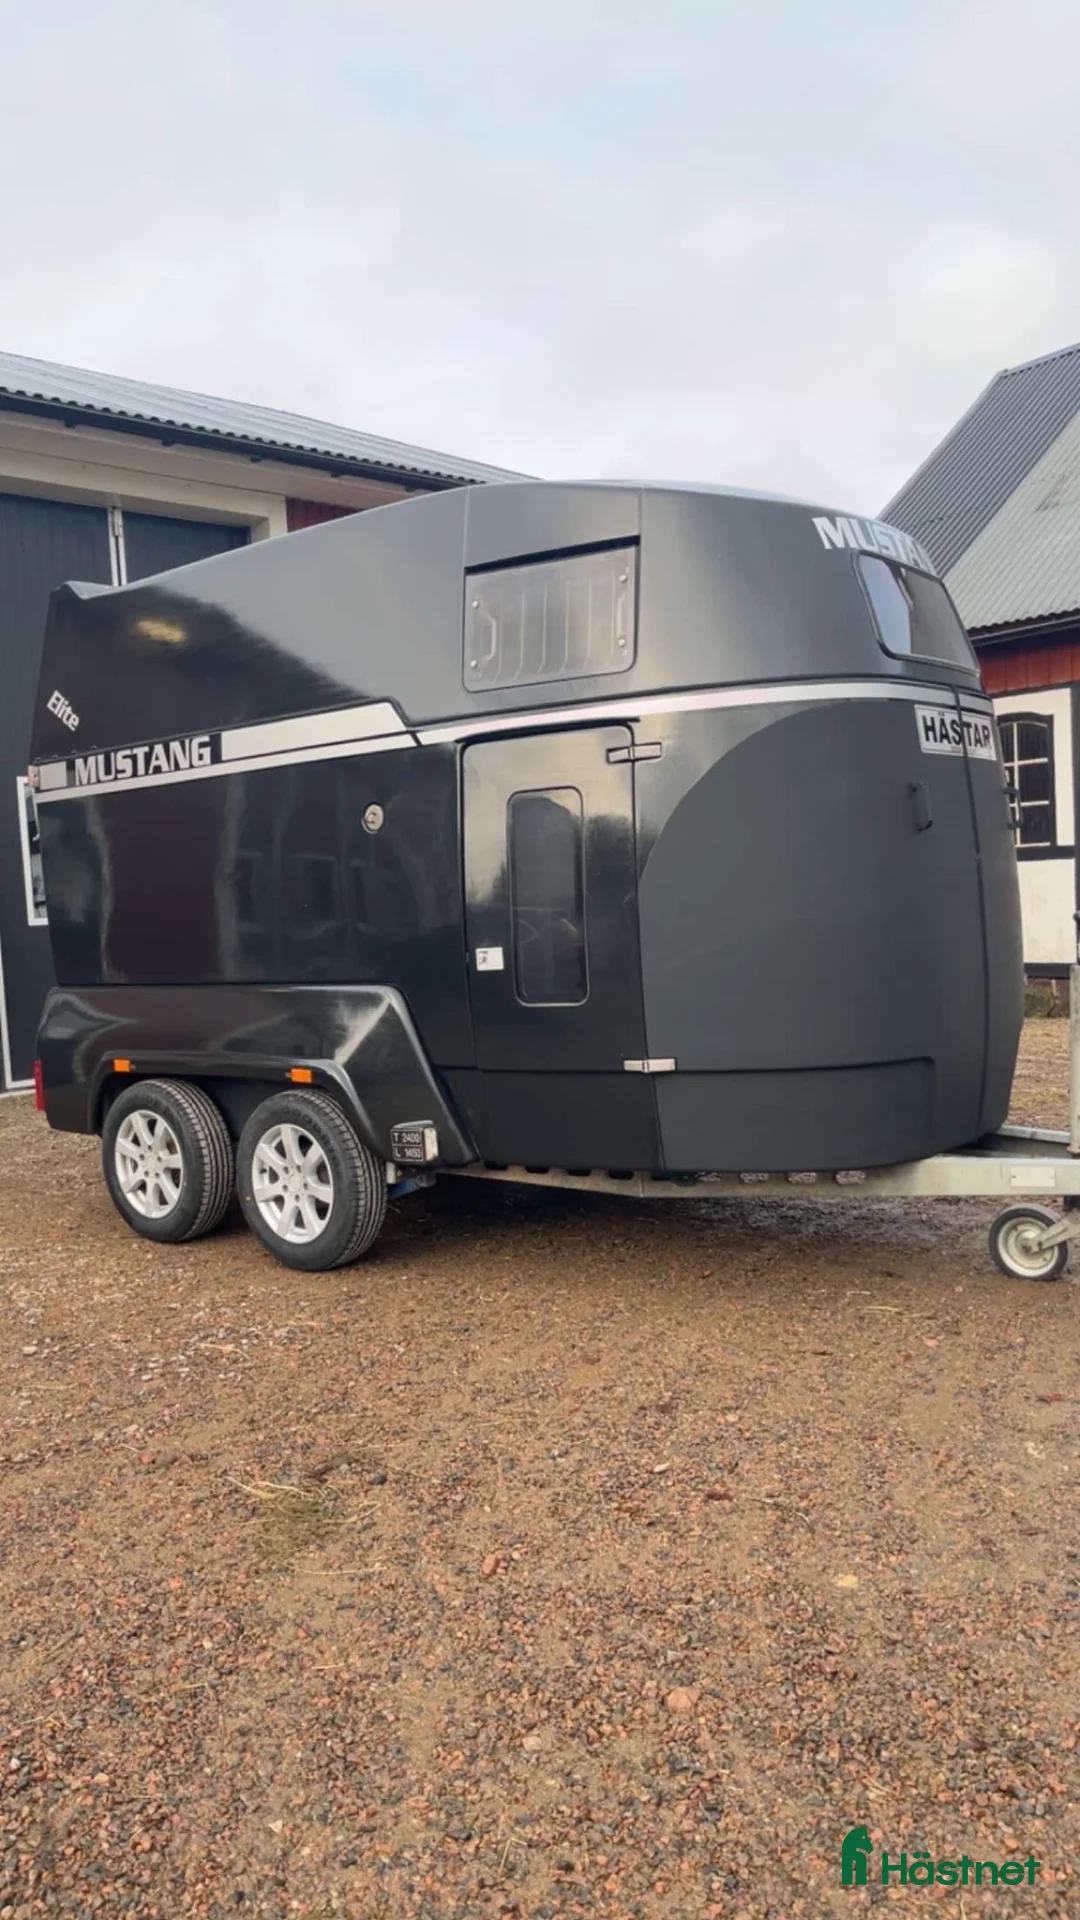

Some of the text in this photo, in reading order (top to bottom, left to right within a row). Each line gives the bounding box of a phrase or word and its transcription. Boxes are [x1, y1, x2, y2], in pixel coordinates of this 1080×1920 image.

[47, 690, 80, 731] Elite
[922, 712, 990, 748] HÄSTAR
[75, 736, 211, 786] MUSTANG
[393, 1132, 400, 1142] T
[395, 1147, 401, 1157] L
